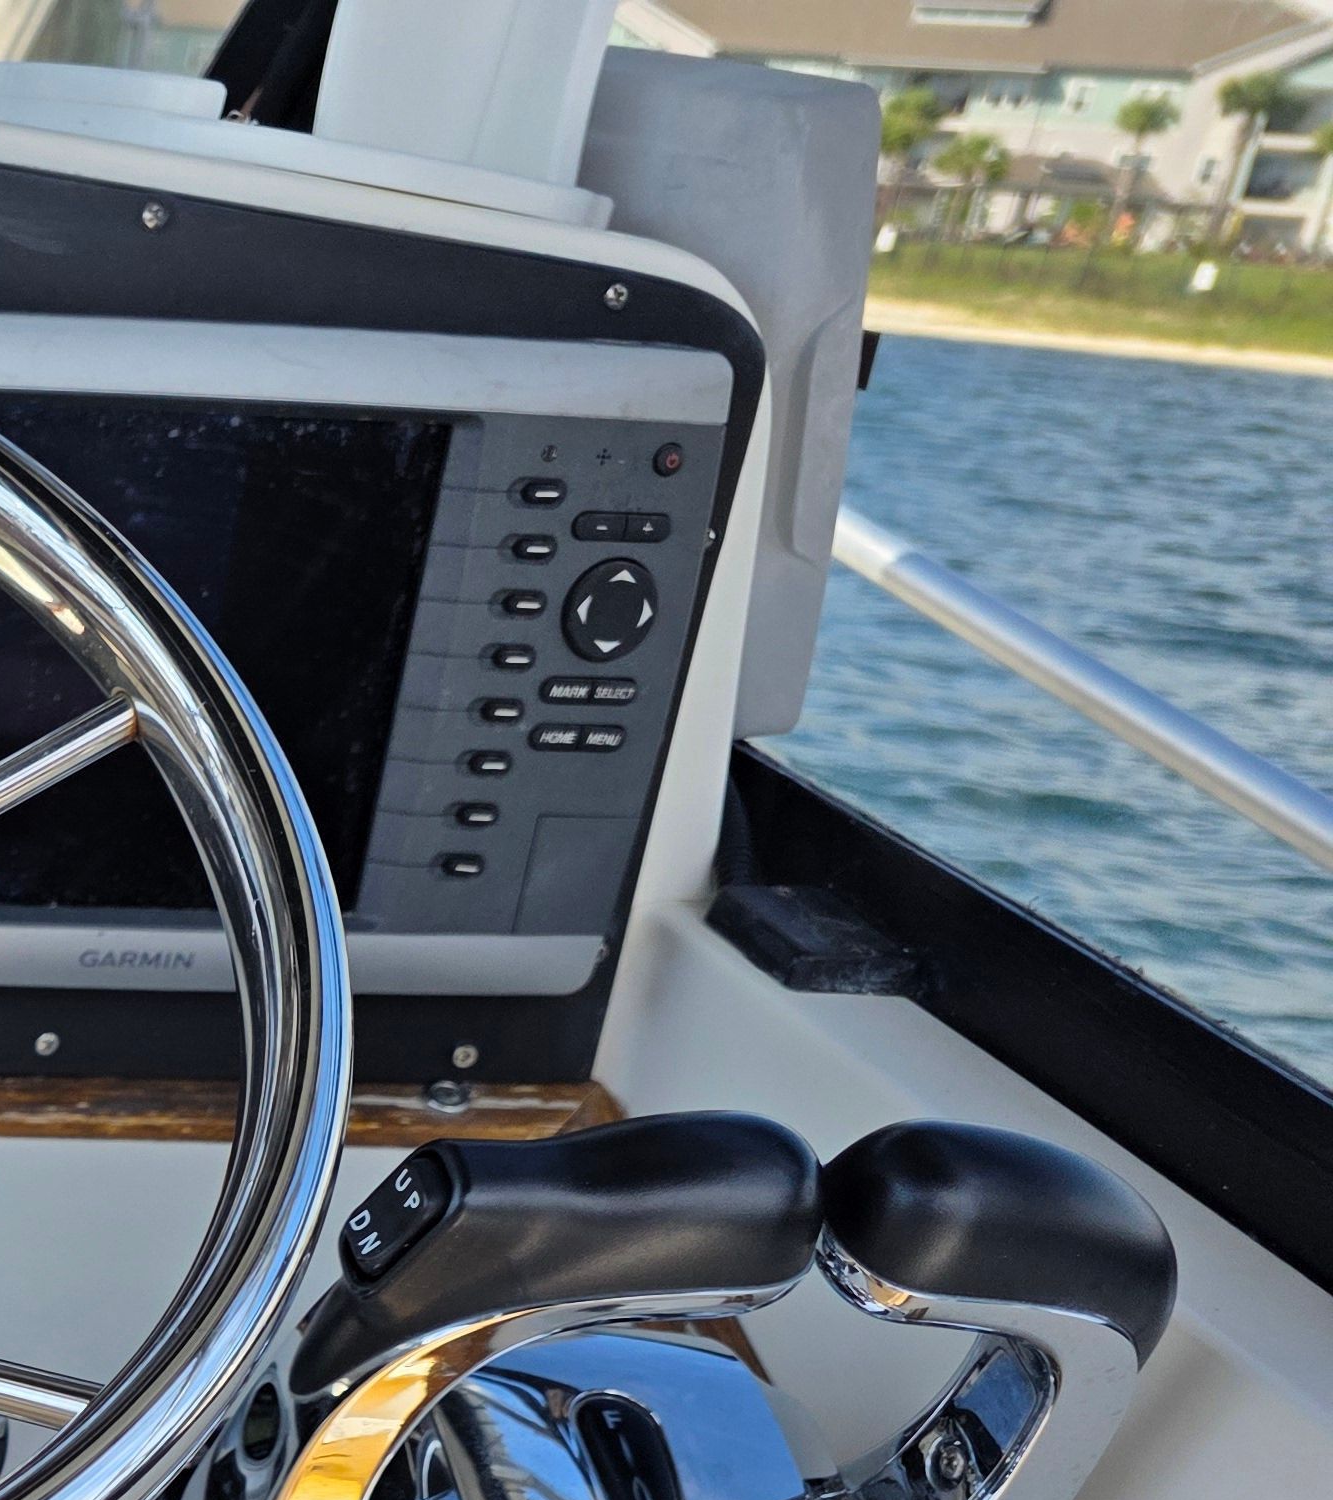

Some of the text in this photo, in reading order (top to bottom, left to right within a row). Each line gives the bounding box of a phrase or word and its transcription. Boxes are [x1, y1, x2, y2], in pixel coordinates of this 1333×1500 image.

[548, 683, 635, 701] MARK SELECT
[538, 729, 622, 748] HOME MENU
[78, 948, 196, 970] GARMIN
[394, 1167, 421, 1210] UP
[348, 1208, 382, 1256] DN
[601, 1410, 623, 1429] F
